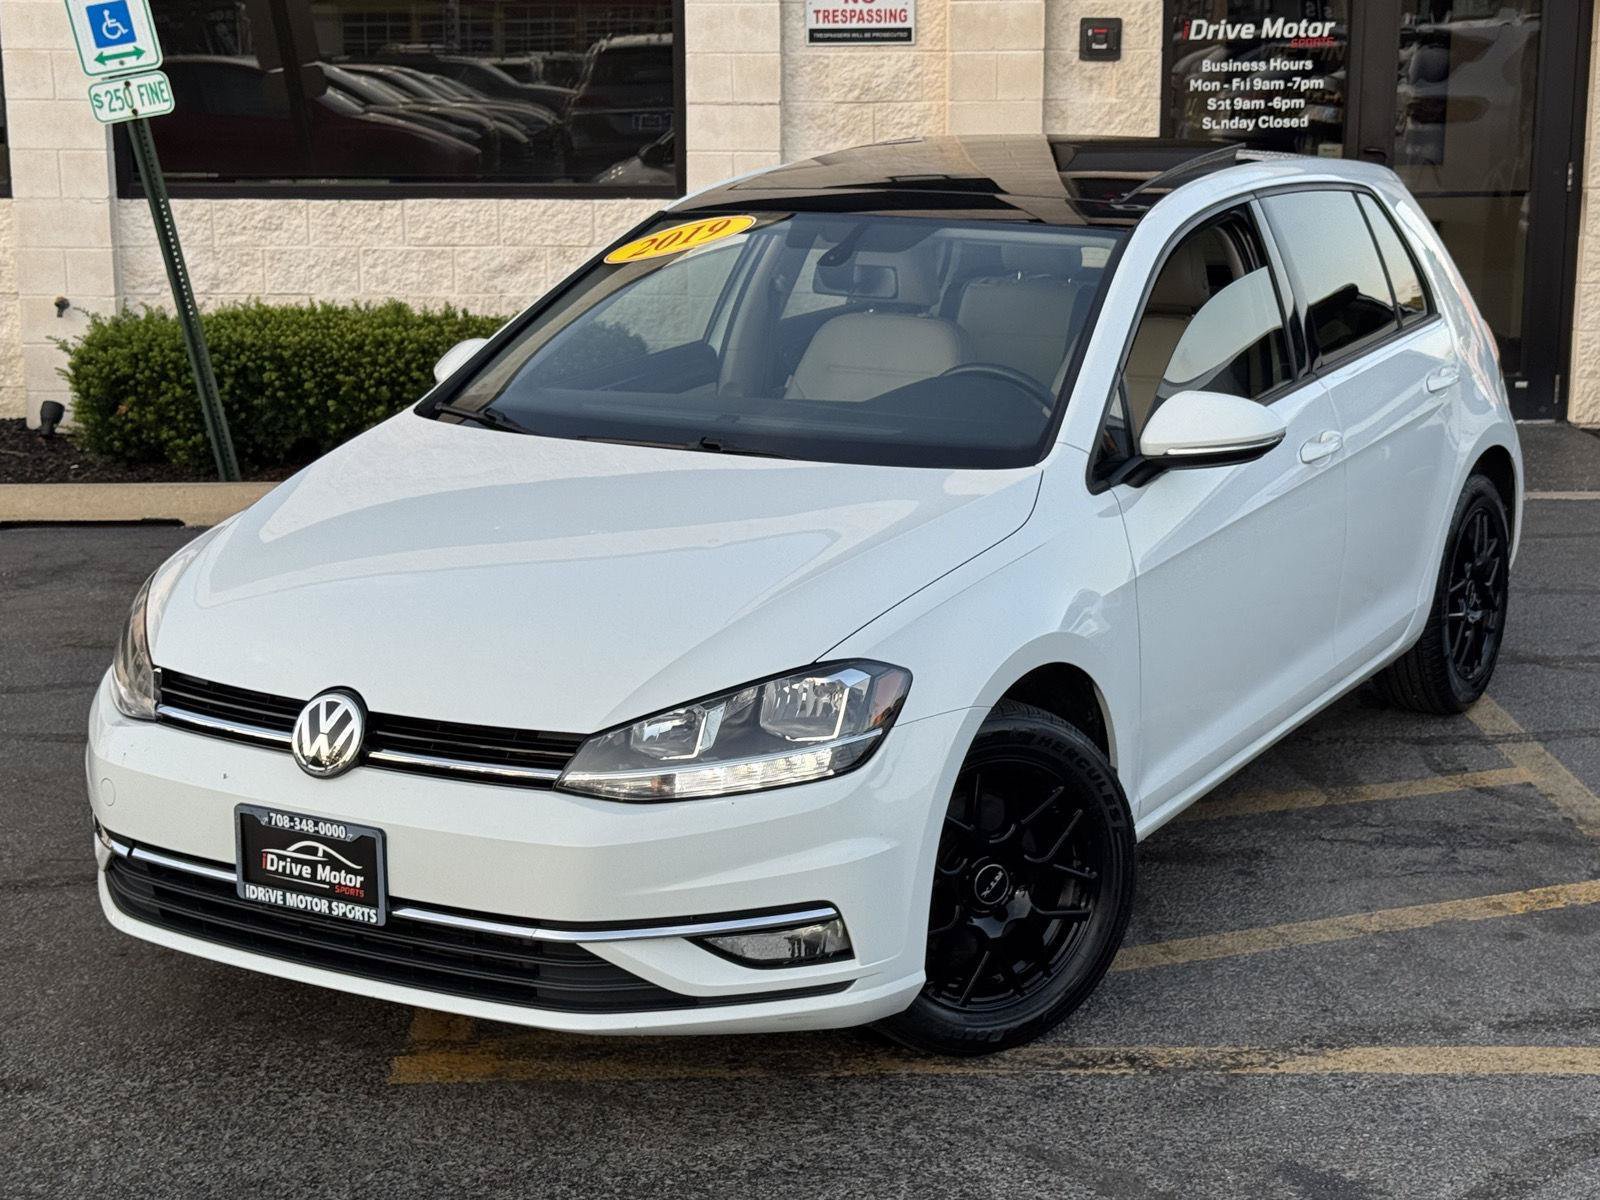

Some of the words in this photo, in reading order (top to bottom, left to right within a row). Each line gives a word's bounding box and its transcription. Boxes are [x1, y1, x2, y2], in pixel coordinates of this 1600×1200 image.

[814, 9, 908, 24] TRESPASSING
[1183, 18, 1256, 40] iDrive
[1260, 16, 1336, 38] Motor
[1201, 59, 1267, 72] Business
[1269, 58, 1313, 71] Hours
[93, 86, 135, 113] $250
[138, 80, 170, 107] FINE
[1189, 79, 1220, 92] Mon
[1253, 78, 1284, 91] 9am
[1233, 97, 1265, 110] 9am
[1258, 114, 1309, 128] Closed
[627, 219, 732, 259] 2019
[1038, 736, 1123, 822] HERCULES
[269, 812, 346, 839] 708-348-0000
[262, 852, 312, 879] iDrive
[317, 864, 364, 888] Motor
[335, 885, 365, 898] SPORTS
[285, 893, 329, 914] MOTOR
[331, 902, 378, 923] SPORTS
